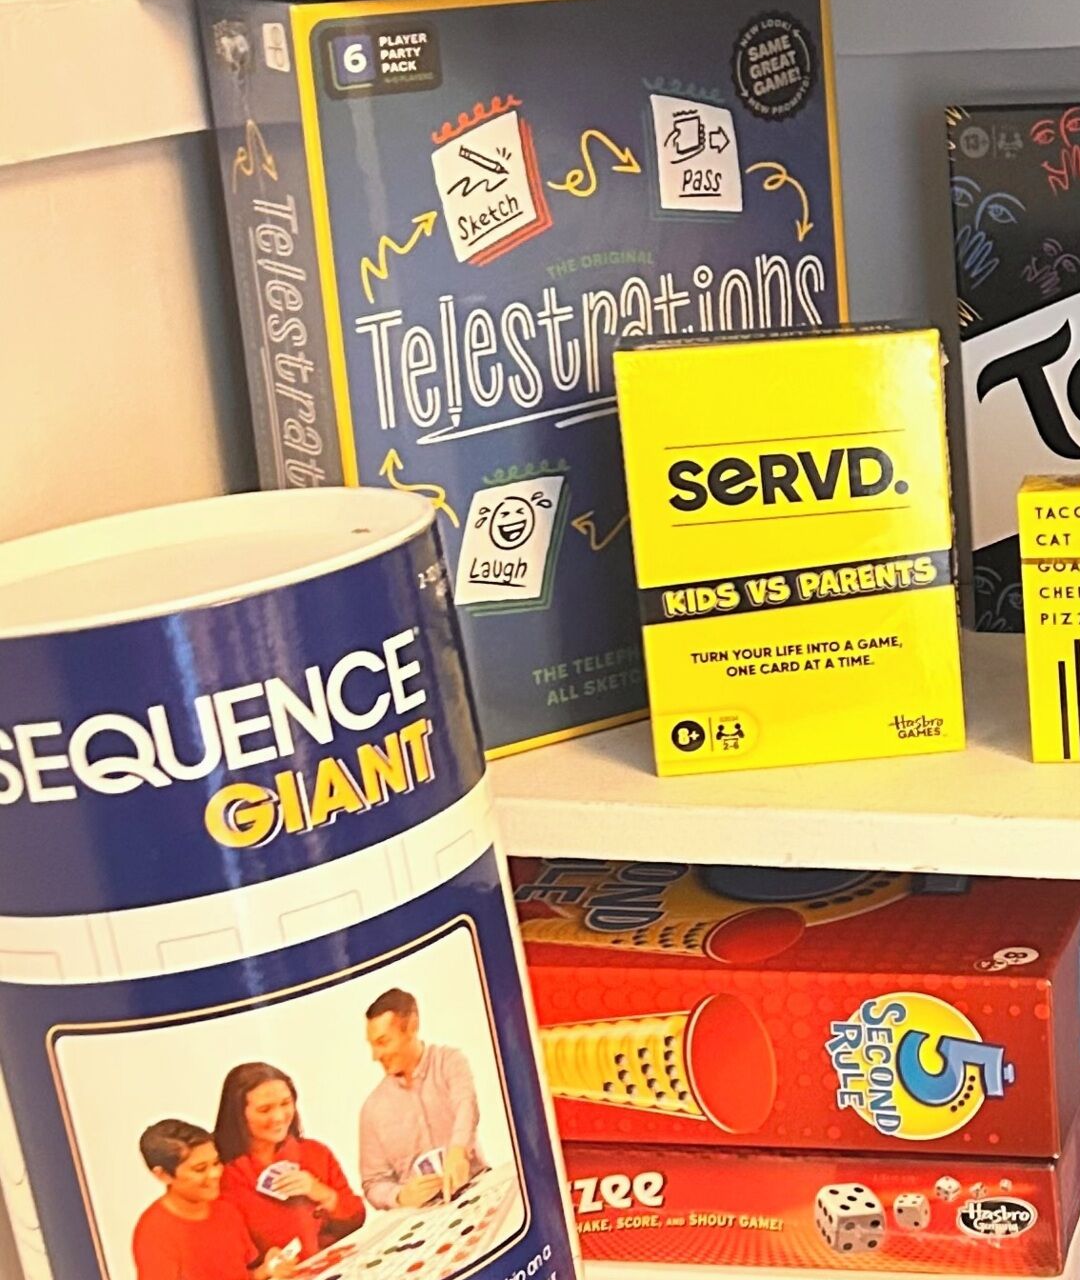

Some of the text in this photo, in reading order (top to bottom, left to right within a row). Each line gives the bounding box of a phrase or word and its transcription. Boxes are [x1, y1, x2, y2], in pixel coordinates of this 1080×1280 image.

[379, 33, 427, 46] PLAYER
[748, 35, 791, 62] SAME
[344, 44, 367, 73] 6
[381, 47, 421, 60] PARTY
[382, 61, 416, 73] PACK
[750, 50, 796, 79] GREAT
[458, 196, 519, 241] Sketch
[1036, 533, 1071, 547] CAT
[470, 558, 528, 584] Laugh
[663, 556, 937, 617] KIDS VS PARENTS
[691, 636, 902, 664] TURN YOUR LIFE INTO A GAME,
[726, 655, 874, 677] ONE CARD AT A TIME.
[677, 727, 700, 746] 8+
[206, 719, 432, 847] GIANT
[828, 1021, 864, 1109] RULE
[861, 1001, 905, 1133] SECOND
[900, 1030, 1004, 1106] 5
[616, 1213, 662, 1232] SCORE,
[690, 1213, 735, 1228] SHOUT
